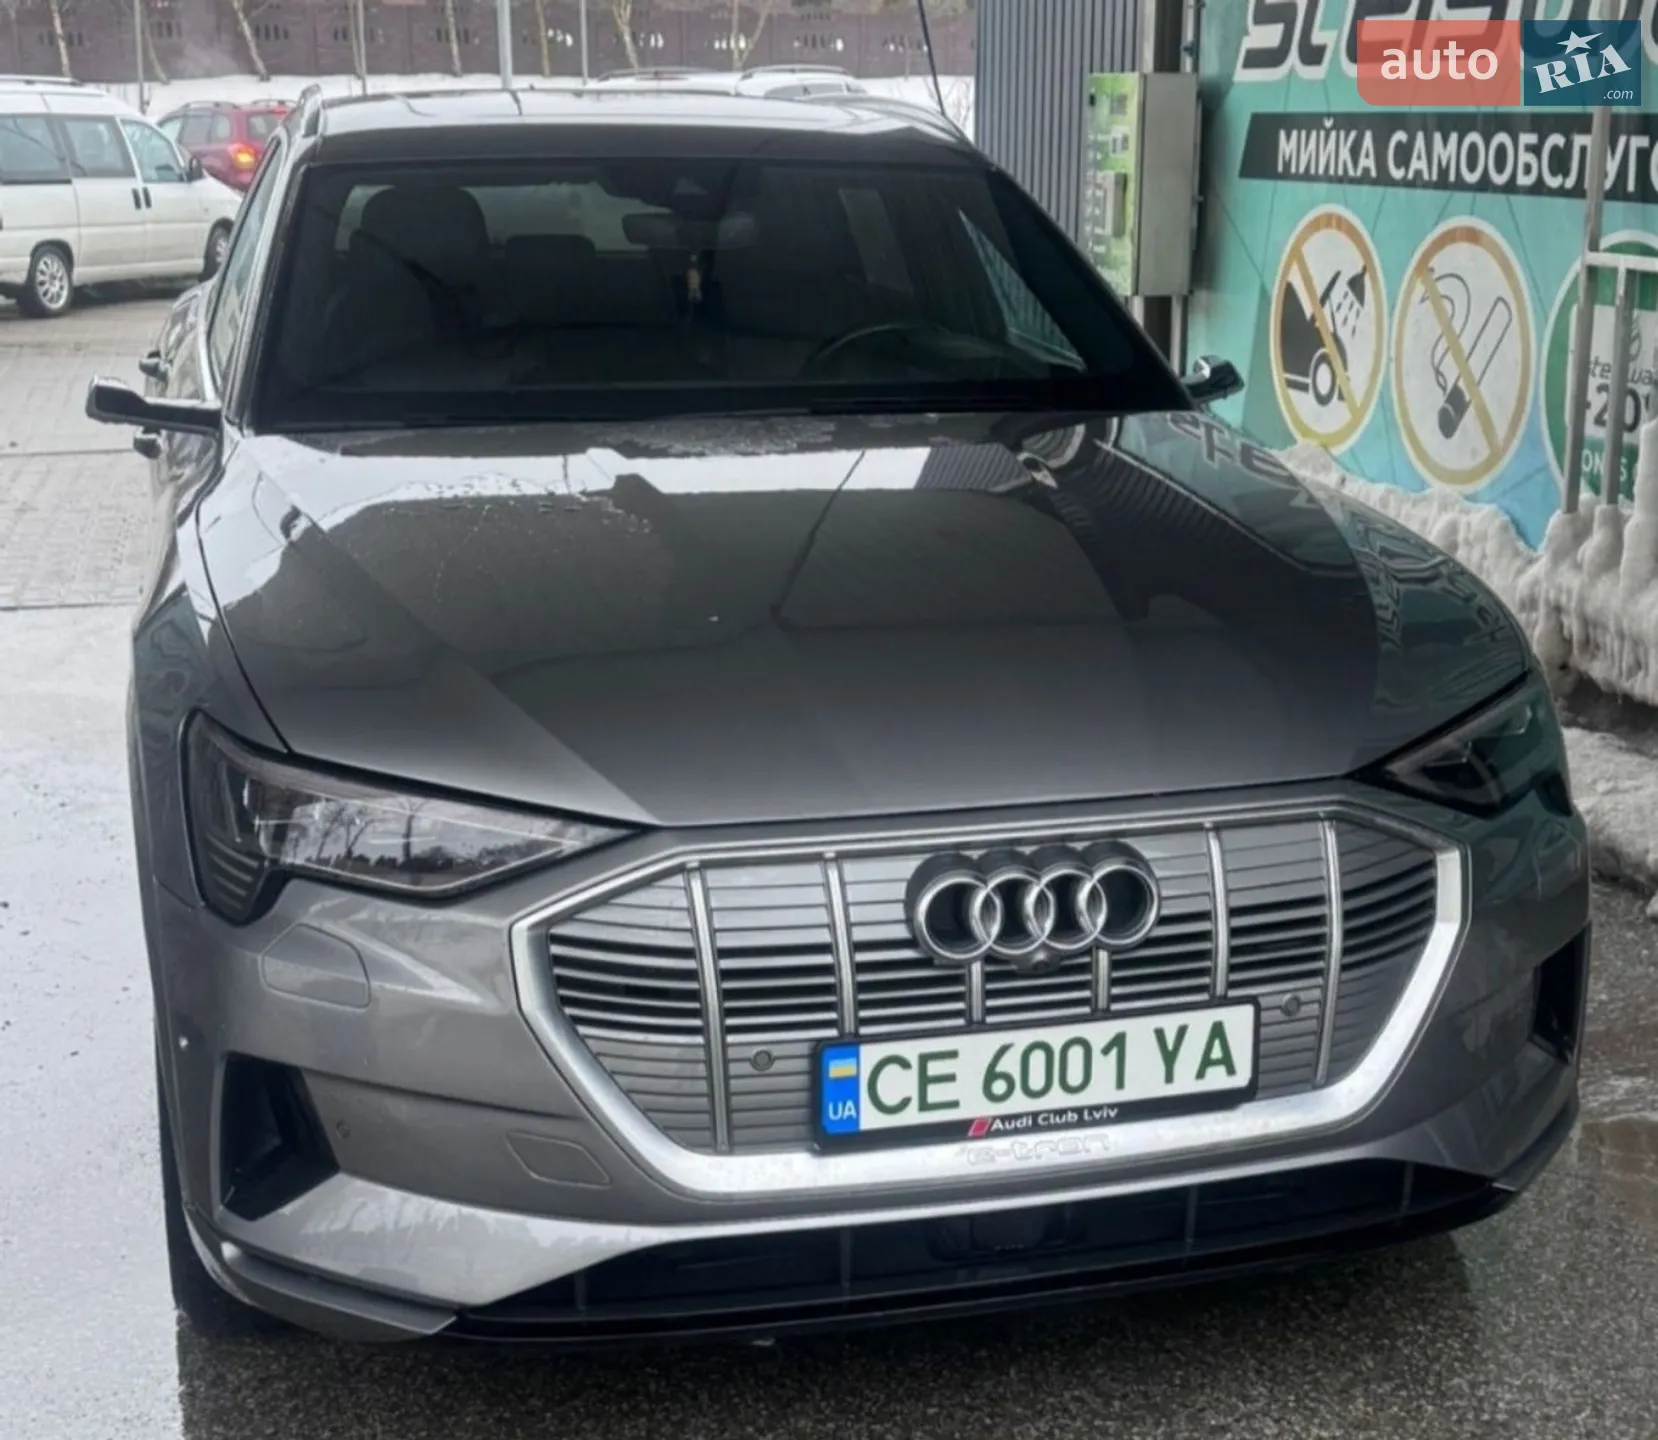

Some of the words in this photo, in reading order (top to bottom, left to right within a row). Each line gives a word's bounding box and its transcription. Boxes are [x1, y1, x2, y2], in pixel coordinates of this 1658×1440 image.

[1277, 117, 1378, 178] МИЙКА
[867, 1048, 960, 1116] CE
[982, 1030, 1127, 1104] 6001
[1154, 1019, 1237, 1085] YA
[828, 1100, 858, 1121] UA
[990, 1115, 1032, 1132] Audi
[1037, 1109, 1079, 1126] Club
[1083, 1106, 1119, 1121] Lviv
[966, 1132, 1111, 1167] e-tron
